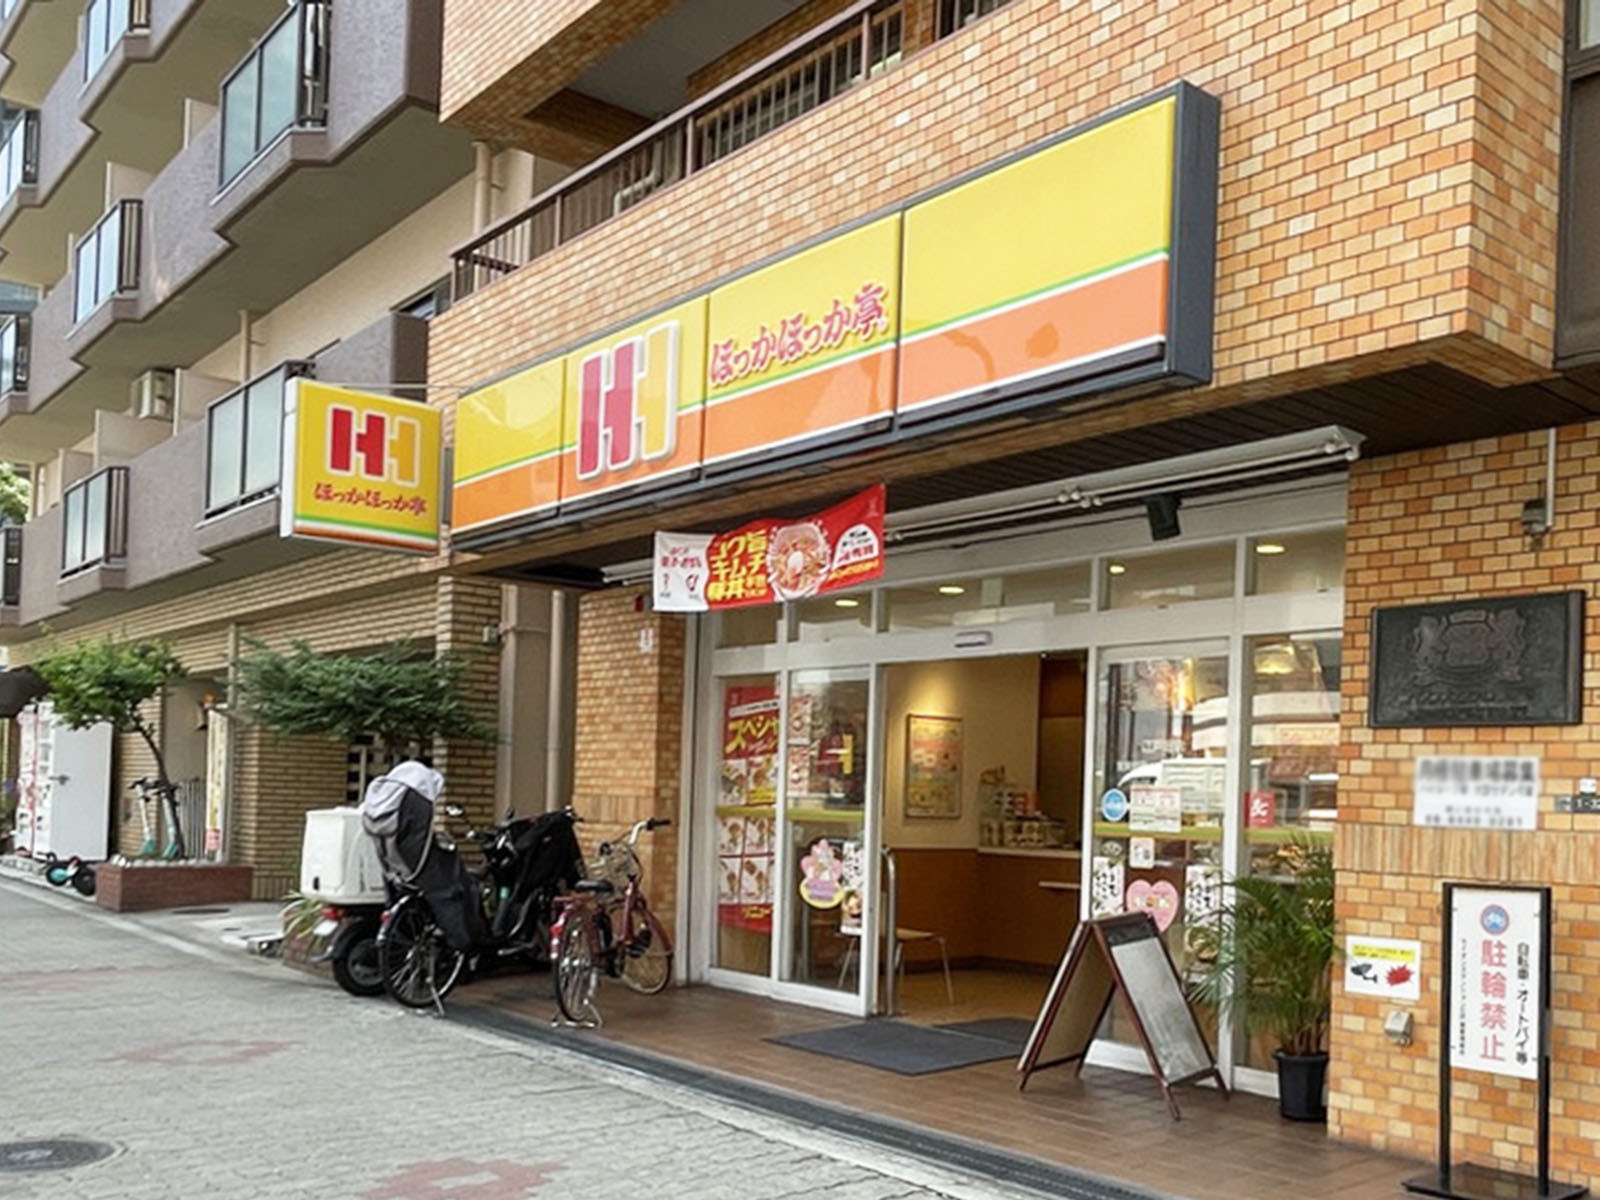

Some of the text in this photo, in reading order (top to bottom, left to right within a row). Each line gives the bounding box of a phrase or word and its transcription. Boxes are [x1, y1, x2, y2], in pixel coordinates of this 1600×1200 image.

[710, 284, 886, 383] ほっかほっか亭
[313, 482, 429, 516] ほっかほっか亭
[1479, 939, 1508, 1062] 駐輪禁止
